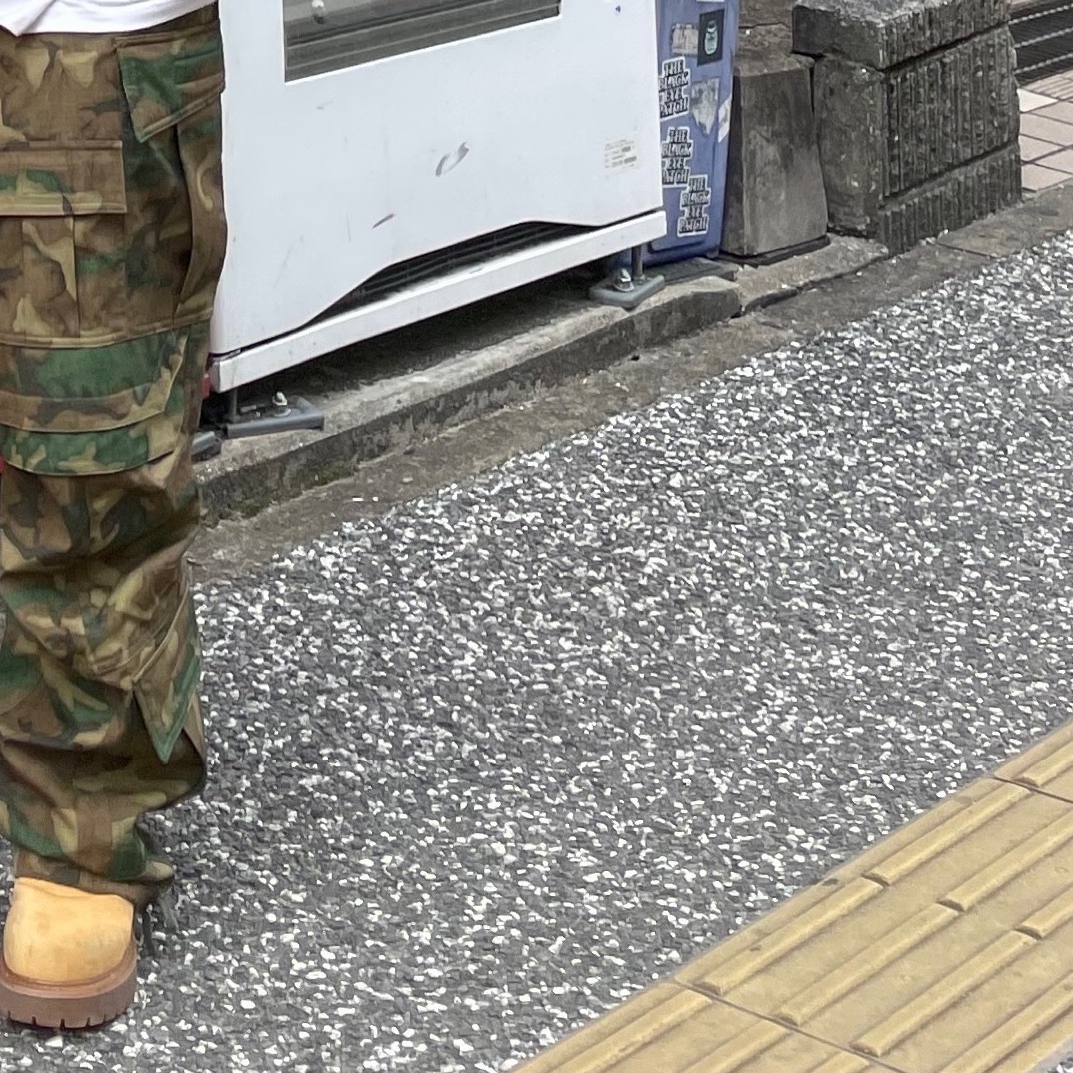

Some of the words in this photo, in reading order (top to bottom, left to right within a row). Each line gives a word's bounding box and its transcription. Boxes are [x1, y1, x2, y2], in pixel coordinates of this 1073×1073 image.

[664, 59, 685, 75] THE
[669, 129, 688, 143] THE
[662, 142, 692, 158] BLACK
[689, 177, 706, 192] THE
[681, 190, 710, 208] BLACK
[679, 216, 709, 234] PATCH
